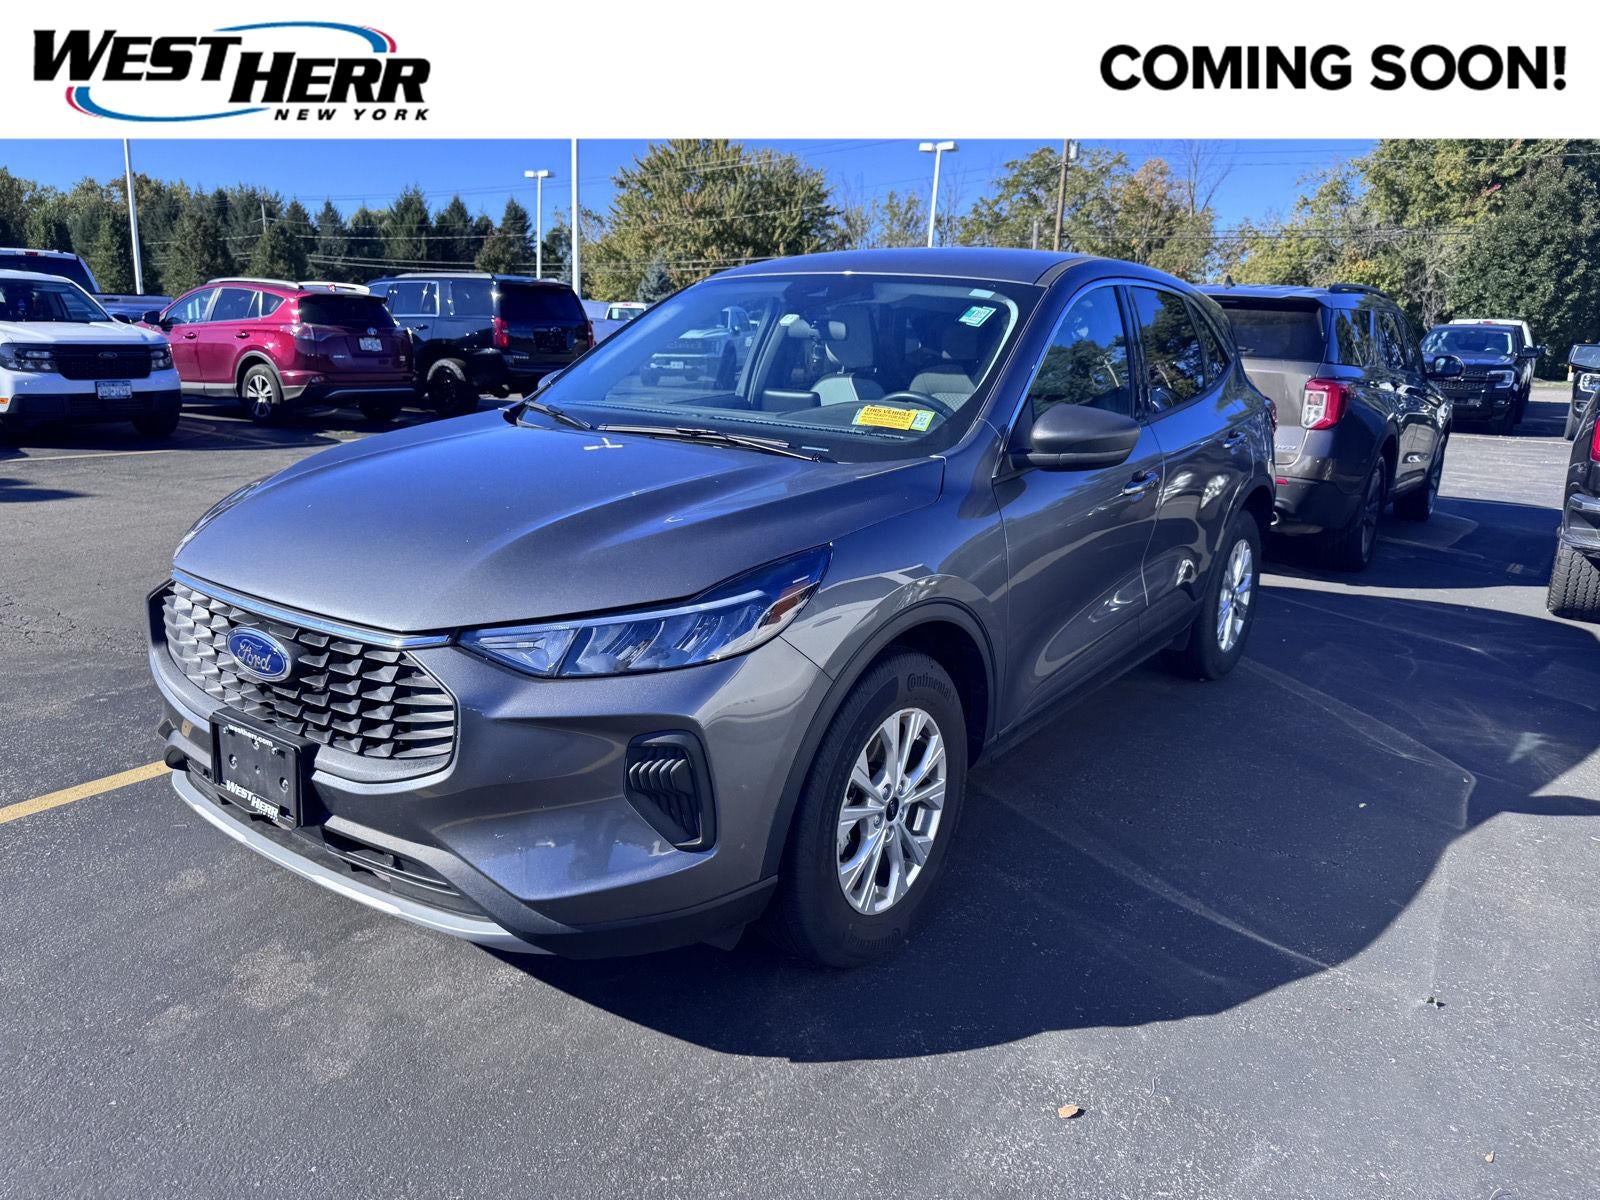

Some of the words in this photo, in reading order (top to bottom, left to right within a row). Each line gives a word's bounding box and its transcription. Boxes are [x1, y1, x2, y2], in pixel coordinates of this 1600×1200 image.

[237, 639, 272, 672] Ford
[226, 780, 254, 801] WEST
[250, 796, 279, 817] HERR
